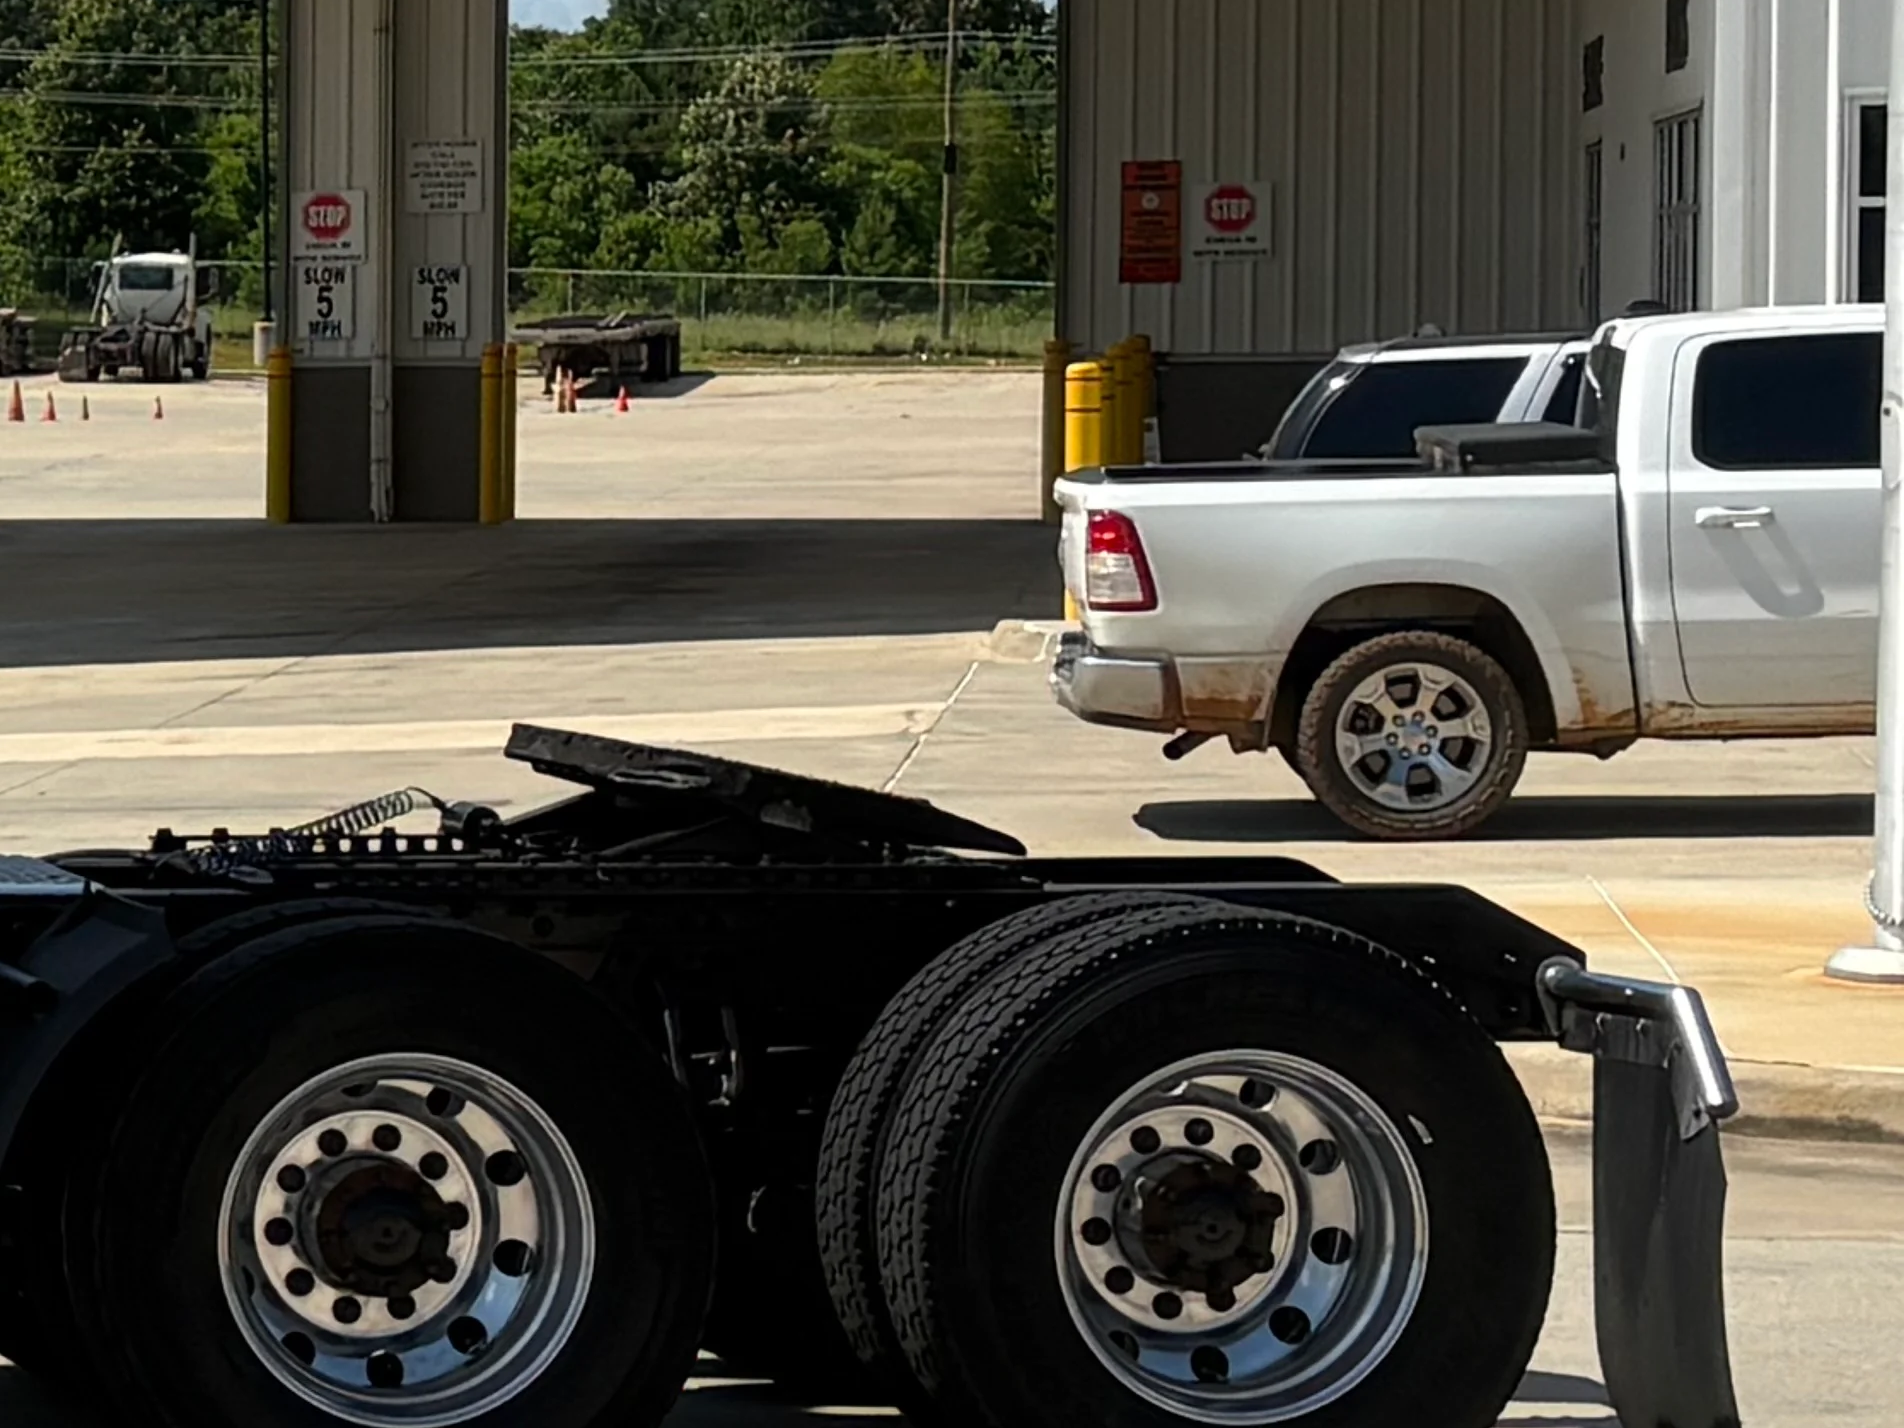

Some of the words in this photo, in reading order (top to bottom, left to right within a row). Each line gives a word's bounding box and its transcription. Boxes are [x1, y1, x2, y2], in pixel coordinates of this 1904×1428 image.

[308, 205, 346, 228] STOP
[1210, 198, 1251, 220] STOP
[304, 267, 346, 285] SLOW
[417, 267, 461, 285] SLOW
[316, 286, 334, 319] 5
[431, 286, 448, 319] 5
[308, 320, 342, 337] MPH
[423, 320, 456, 337] MPH
